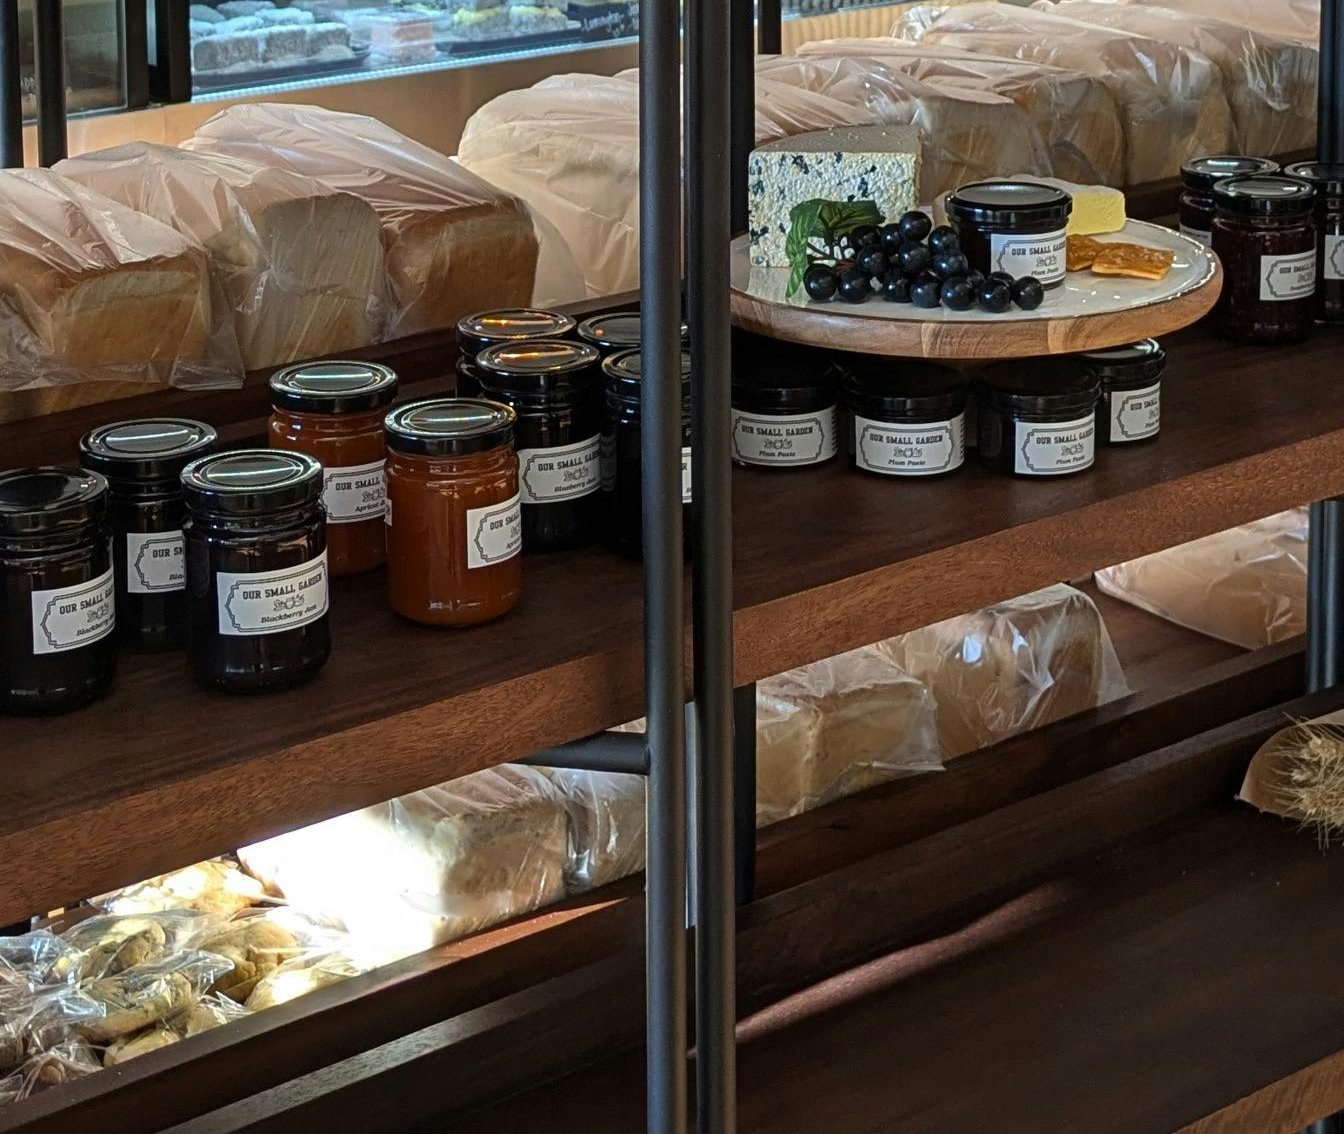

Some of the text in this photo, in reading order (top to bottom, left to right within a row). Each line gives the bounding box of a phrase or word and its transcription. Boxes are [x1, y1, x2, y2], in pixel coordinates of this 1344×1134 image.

[1012, 245, 1051, 256] OUR SMALL
[1130, 402, 1142, 412] OUR
[741, 426, 813, 436] OUR SMALL GARDEN
[869, 434, 943, 445] OUR SMALL GARDEN
[1036, 434, 1077, 445] OUR SMALL
[537, 458, 583, 471] OUR SMALL
[335, 477, 380, 491] OUR SMALL
[554, 483, 585, 493] Blueberry
[355, 502, 378, 513] Apricot
[489, 520, 504, 530] OUR
[152, 548, 170, 558] OUR
[242, 573, 323, 599] OUR SMALL GARDEN
[59, 595, 104, 615] OUR SMALL
[260, 604, 317, 624] Blackberry Jam
